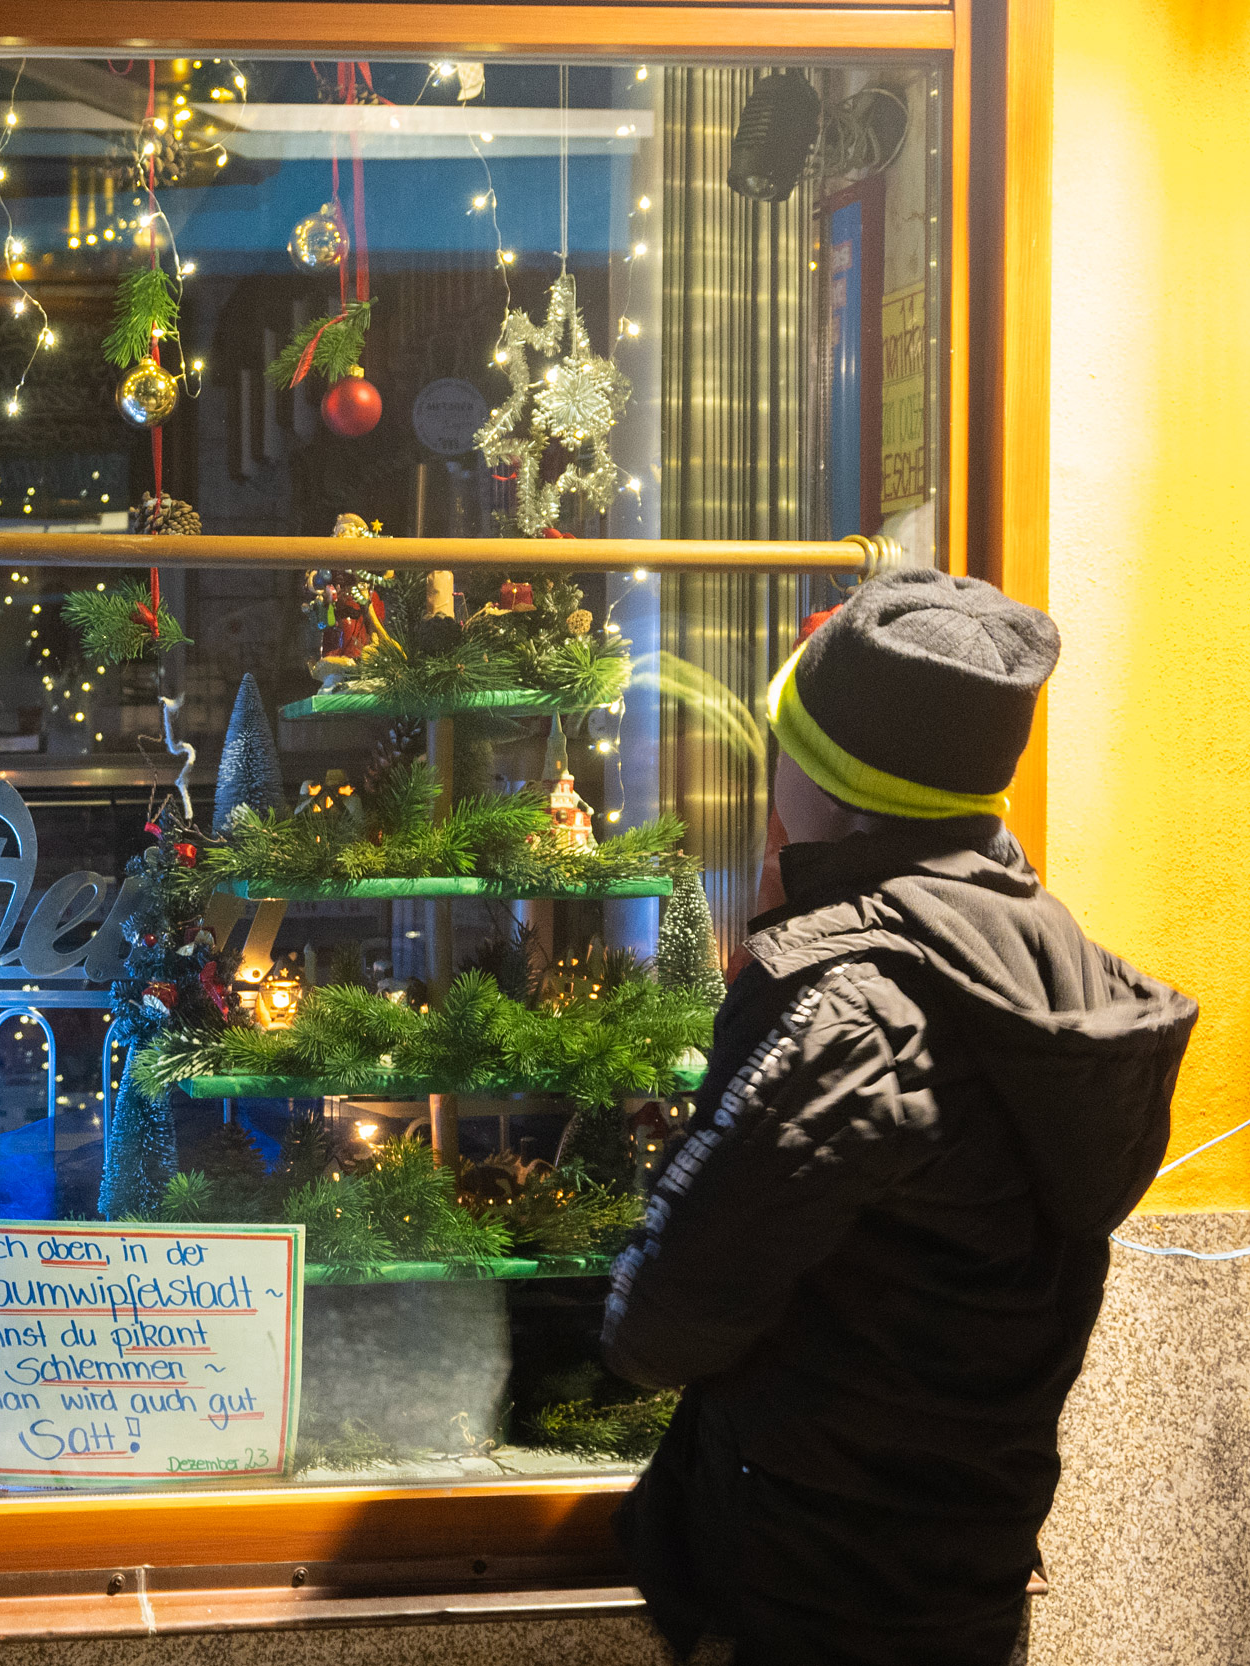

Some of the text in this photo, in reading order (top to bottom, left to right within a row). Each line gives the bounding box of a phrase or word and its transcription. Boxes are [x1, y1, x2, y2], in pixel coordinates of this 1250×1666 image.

[38, 1235, 111, 1265] oben,
[121, 1237, 147, 1263] in
[166, 1240, 209, 1266] der
[60, 1320, 97, 1347] du
[111, 1319, 209, 1358] pikant
[5, 1355, 184, 1385] Schlemmen
[60, 1387, 118, 1412] wird
[130, 1389, 197, 1414] auch
[208, 1388, 257, 1431] gut
[166, 1447, 270, 1473] Dezember 23
